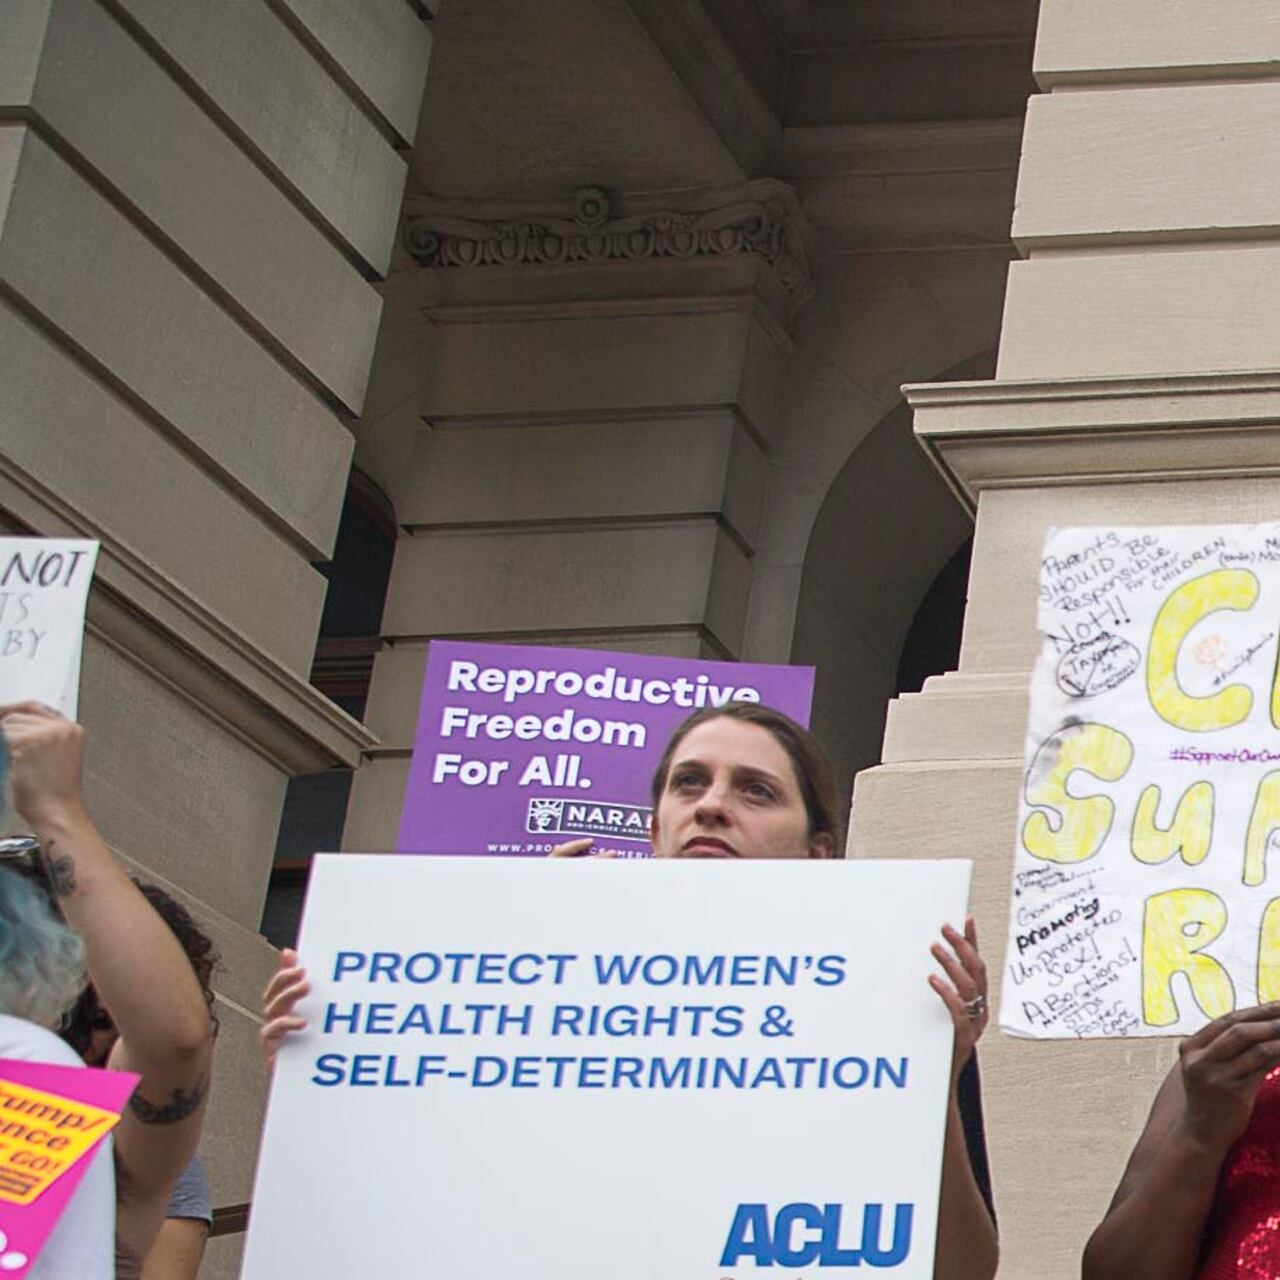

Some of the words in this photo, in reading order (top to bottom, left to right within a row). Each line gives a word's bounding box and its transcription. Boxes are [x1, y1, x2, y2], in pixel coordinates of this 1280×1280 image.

[1, 550, 88, 587] NOT
[447, 660, 761, 708] Reproductive
[439, 706, 647, 749] Freedom
[433, 753, 508, 786] For
[518, 754, 593, 789] All.
[332, 951, 577, 985] PROTECT
[593, 954, 849, 987] WOMEN'S
[322, 1003, 534, 1037] HEALTH
[550, 1005, 745, 1038] RIGHTS
[759, 1005, 796, 1038] &
[311, 1053, 910, 1090] SELF-DETERMINATION
[0, 1090, 109, 1133] ump/
[718, 1202, 915, 1268] ACLU
